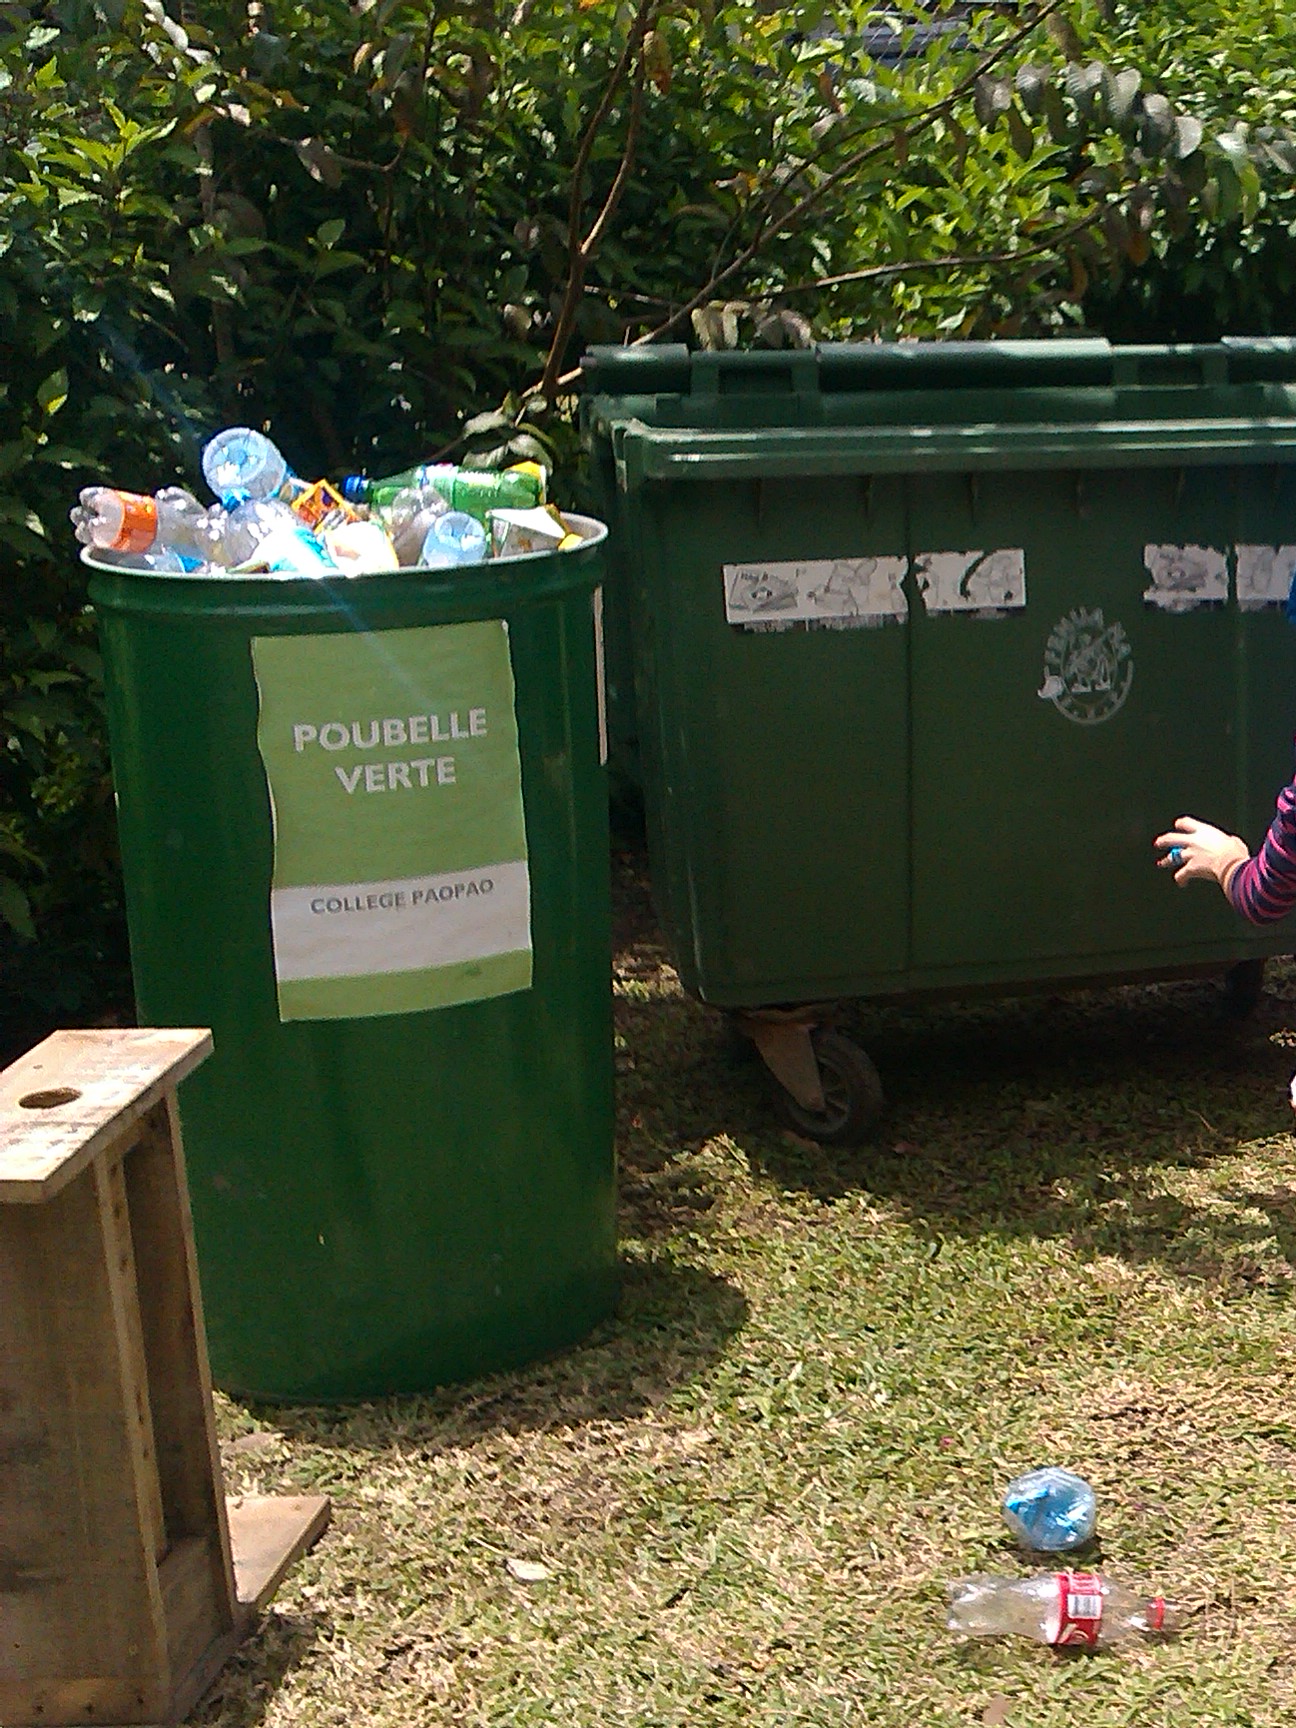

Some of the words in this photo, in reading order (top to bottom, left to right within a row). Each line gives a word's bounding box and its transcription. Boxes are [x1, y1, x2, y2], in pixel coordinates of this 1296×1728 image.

[293, 706, 488, 752] POUBELLE
[334, 756, 457, 794] VERTE
[310, 891, 406, 914] COLLEGE
[412, 878, 495, 906] PAOPAO
